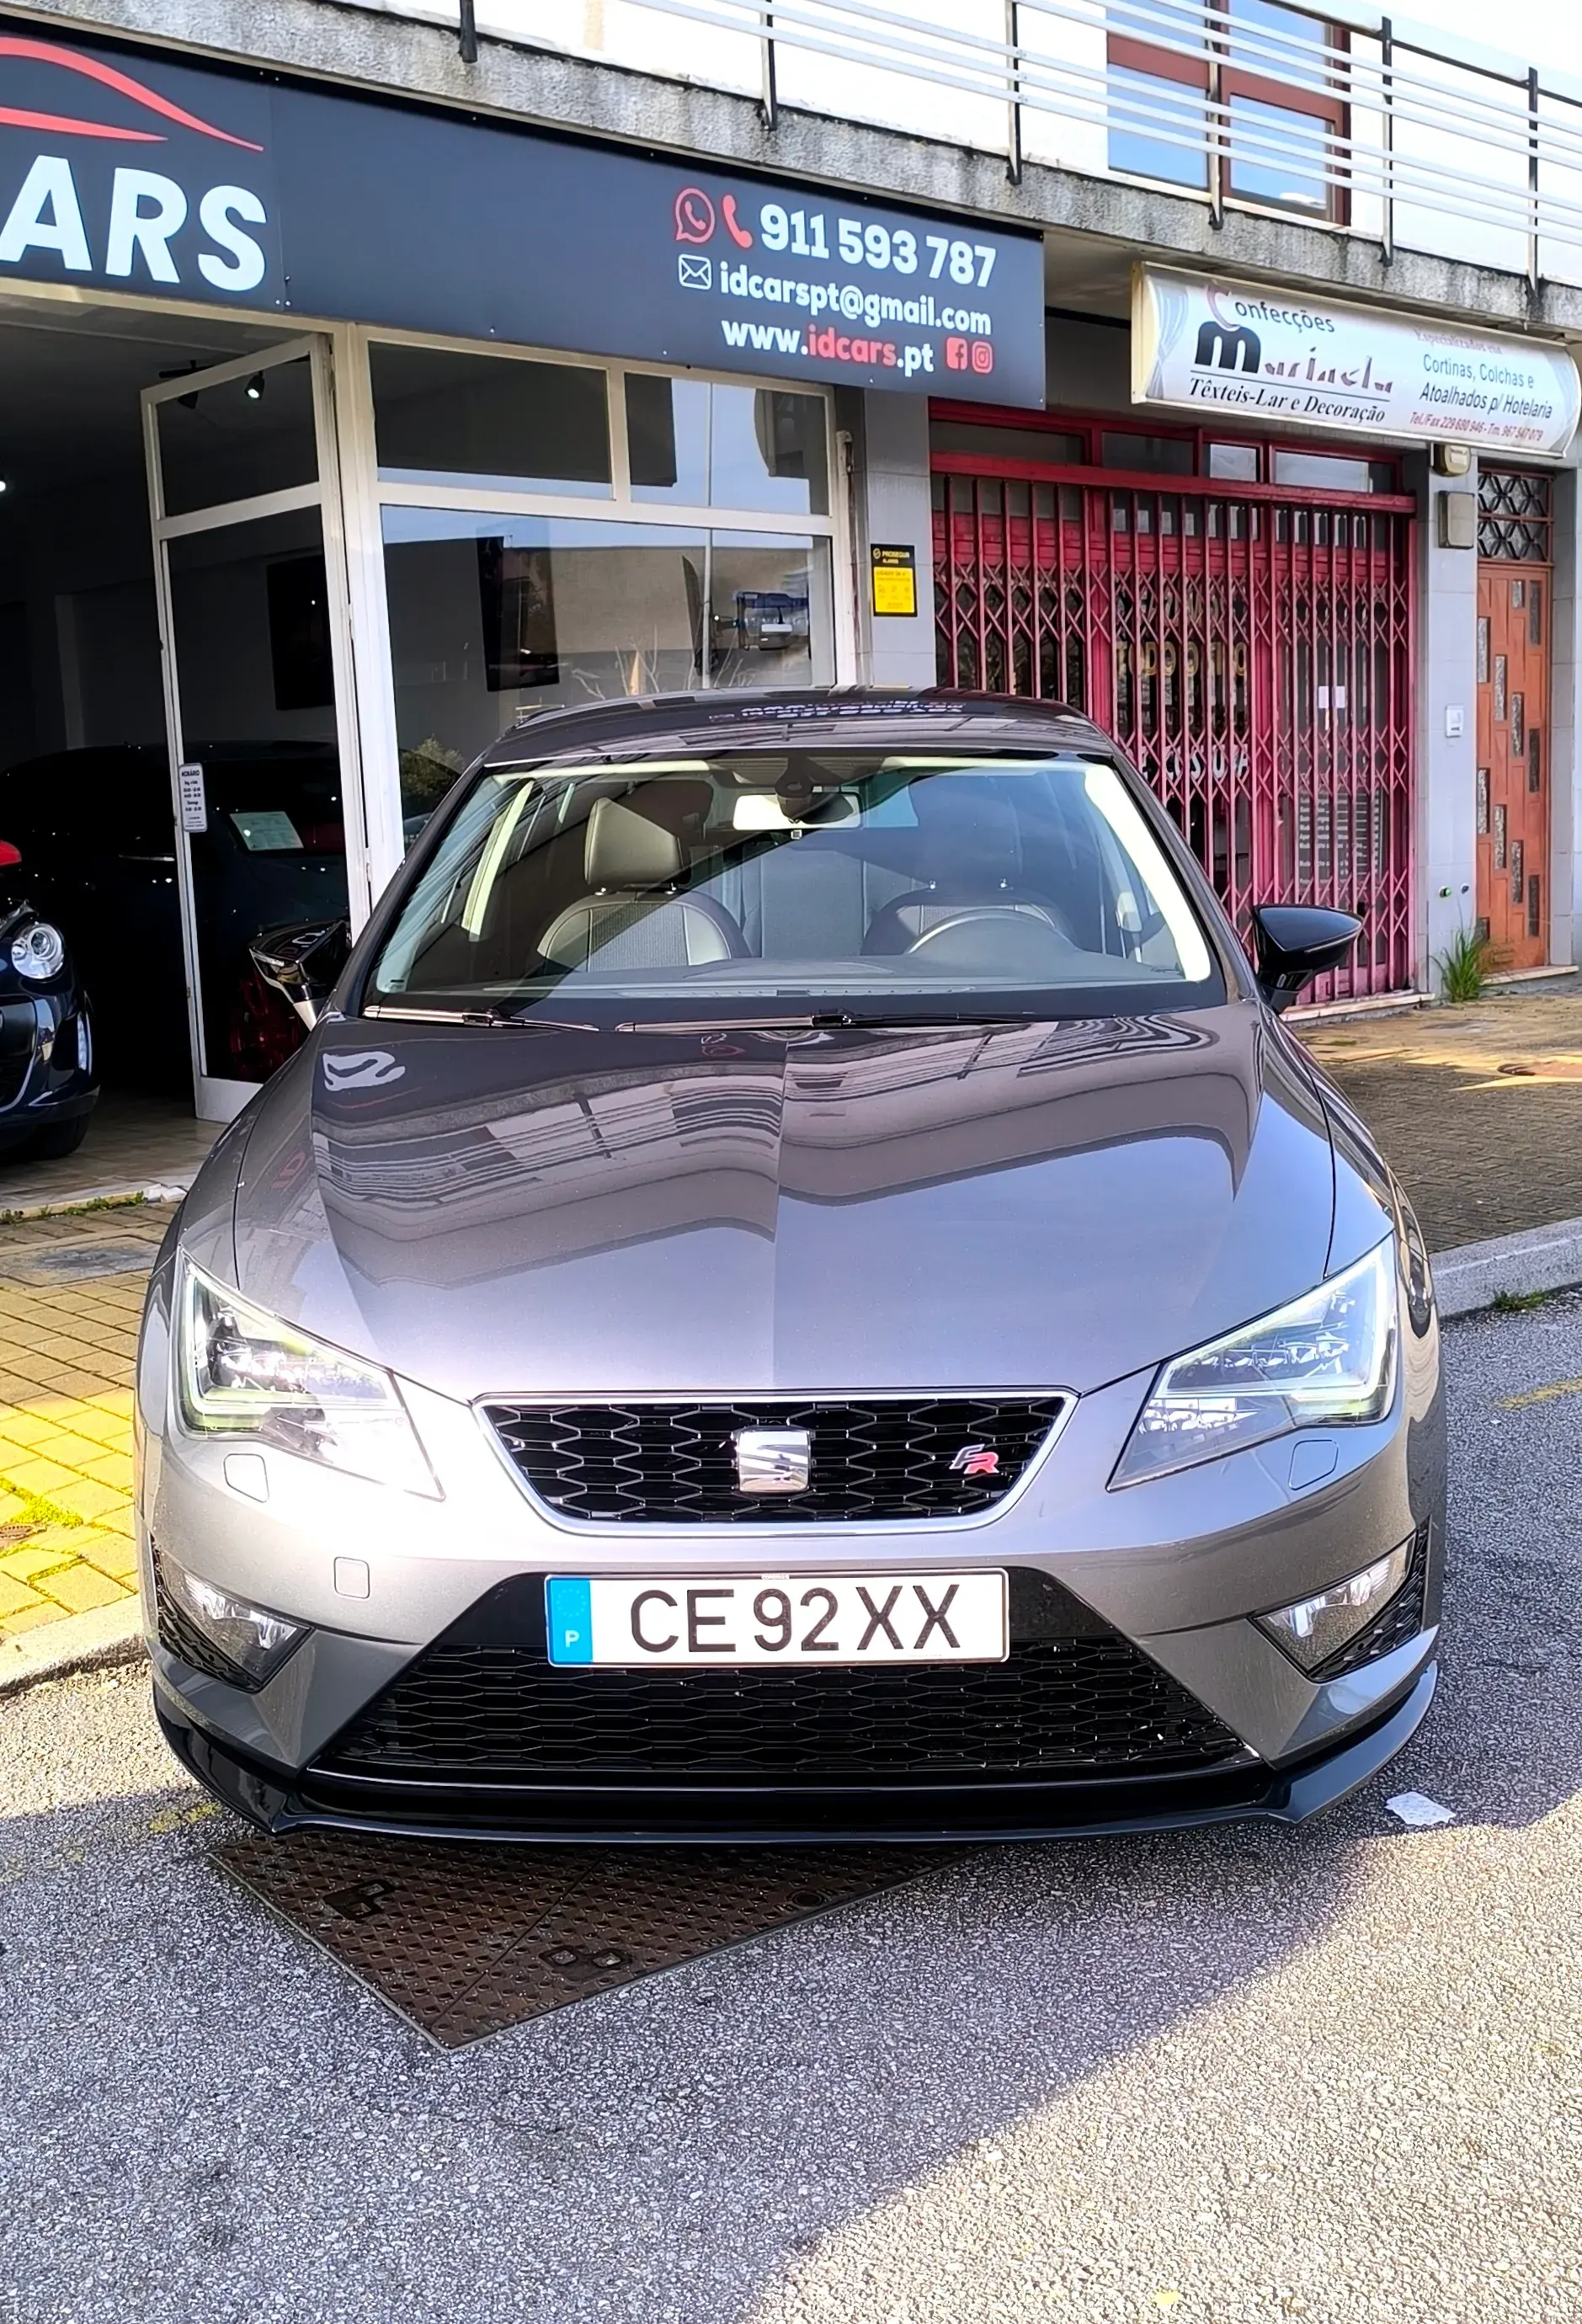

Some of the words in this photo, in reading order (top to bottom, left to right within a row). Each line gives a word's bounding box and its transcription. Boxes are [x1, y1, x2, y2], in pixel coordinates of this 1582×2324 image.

[0, 154, 267, 291] ARS
[760, 204, 829, 259] 911
[838, 218, 919, 275] 593
[926, 235, 997, 288] 787
[720, 261, 992, 335] idcarspt@gmail.com
[1206, 281, 1335, 333] Confecções
[721, 320, 935, 377] www.idcars.pt
[1423, 354, 1476, 382] Cortinas,
[1479, 363, 1524, 388] Colchas
[1527, 376, 1534, 389] e
[1189, 377, 1288, 409] Têxteis-Lar
[1291, 397, 1300, 411] e
[1303, 396, 1385, 424] Decoração
[1419, 382, 1487, 410] Atoalhados
[1503, 395, 1553, 419] Hotelaria
[949, 1443, 999, 1474] FR
[565, 1629, 579, 1648] P
[631, 1588, 737, 1653] CE
[753, 1587, 839, 1652] 92
[855, 1584, 961, 1650] XX
